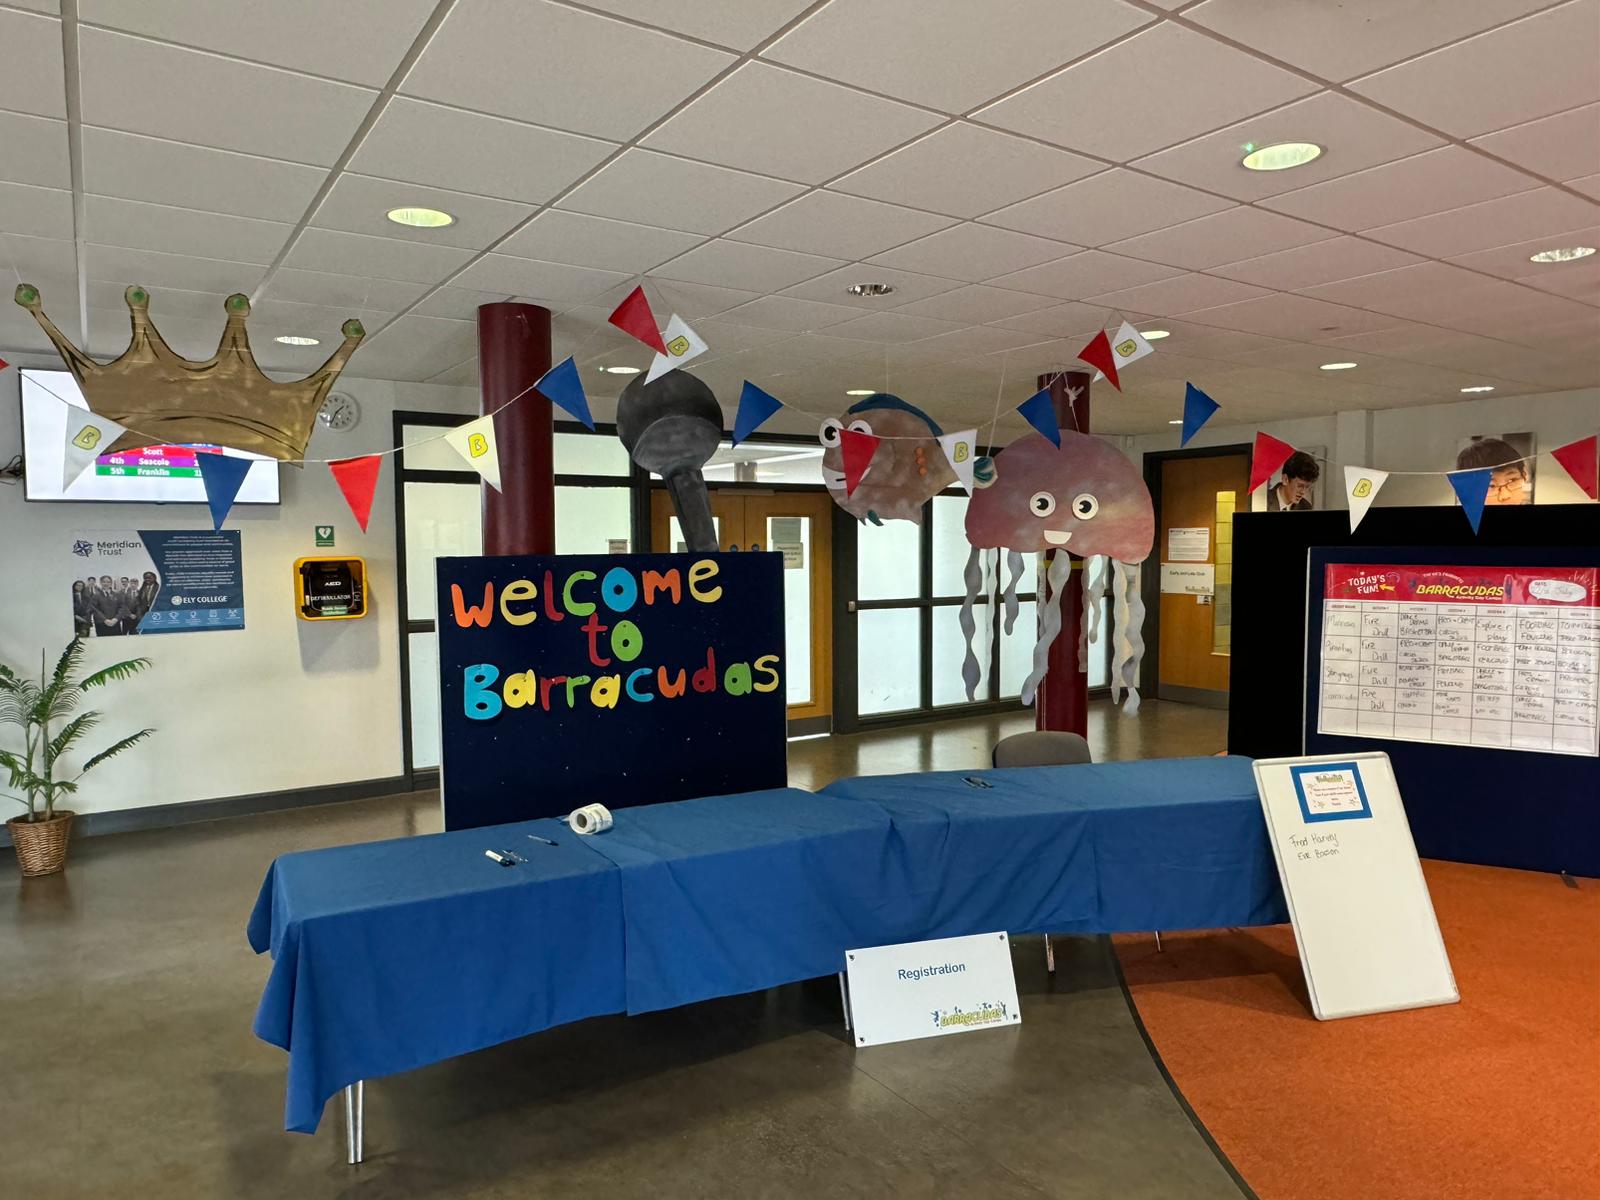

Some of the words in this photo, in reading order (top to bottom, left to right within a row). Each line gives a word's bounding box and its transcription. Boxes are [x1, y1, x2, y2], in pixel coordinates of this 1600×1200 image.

[467, 433, 488, 458] B
[953, 441, 969, 463] B
[109, 456, 125, 465] 4th
[109, 467, 125, 475] 5th
[137, 467, 170, 476] Franklin
[1352, 477, 1372, 498] B
[96, 540, 142, 549] Meridian
[97, 548, 122, 556] Trust
[1347, 574, 1386, 587] TODAY'S
[450, 559, 723, 628] Welcome
[1356, 583, 1380, 594] FUN!
[1416, 584, 1505, 597] BARRACUDAS
[182, 595, 196, 604] ELY
[196, 594, 228, 603] COLLEGE
[1364, 614, 1379, 625] Fire
[1372, 627, 1389, 637] Drill
[581, 613, 644, 667] to
[1361, 640, 1375, 649] Fire
[1372, 651, 1389, 661] Drill
[1362, 666, 1378, 675] Fire
[463, 647, 780, 720] Barracudas
[1361, 688, 1377, 699] Fire
[898, 962, 966, 980] Registration
